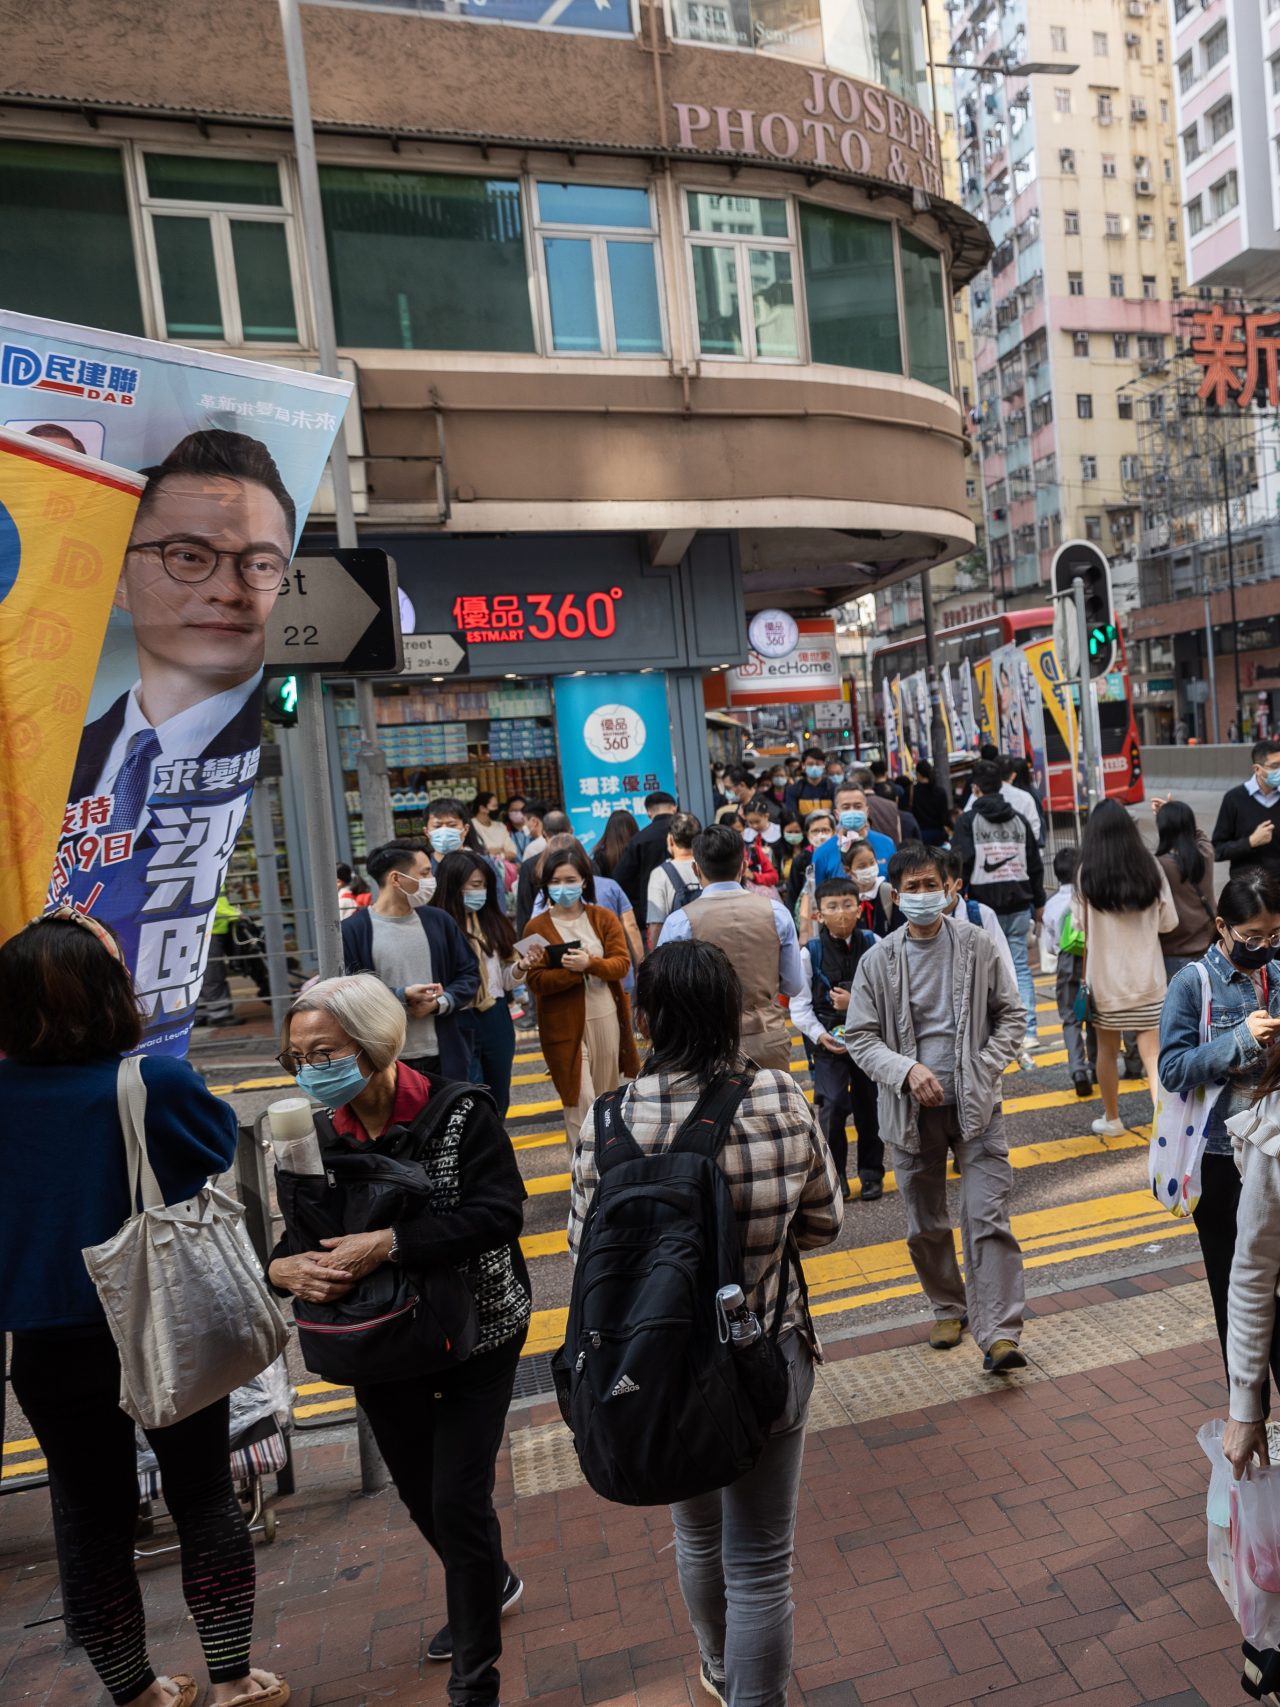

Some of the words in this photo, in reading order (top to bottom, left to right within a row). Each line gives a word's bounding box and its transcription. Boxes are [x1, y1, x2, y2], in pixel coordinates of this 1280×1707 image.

[803, 70, 938, 168] JOSEPH
[672, 102, 872, 174] PHOTO
[887, 143, 909, 183] &
[45, 352, 139, 394] 民建聯
[87, 390, 134, 406] DAB
[453, 595, 525, 630] 優品
[283, 625, 319, 647] 22
[402, 638, 433, 651] reet
[465, 628, 525, 644] ESTMART
[131, 1035, 163, 1054] dward
[611, 1383, 641, 1398] adidas
